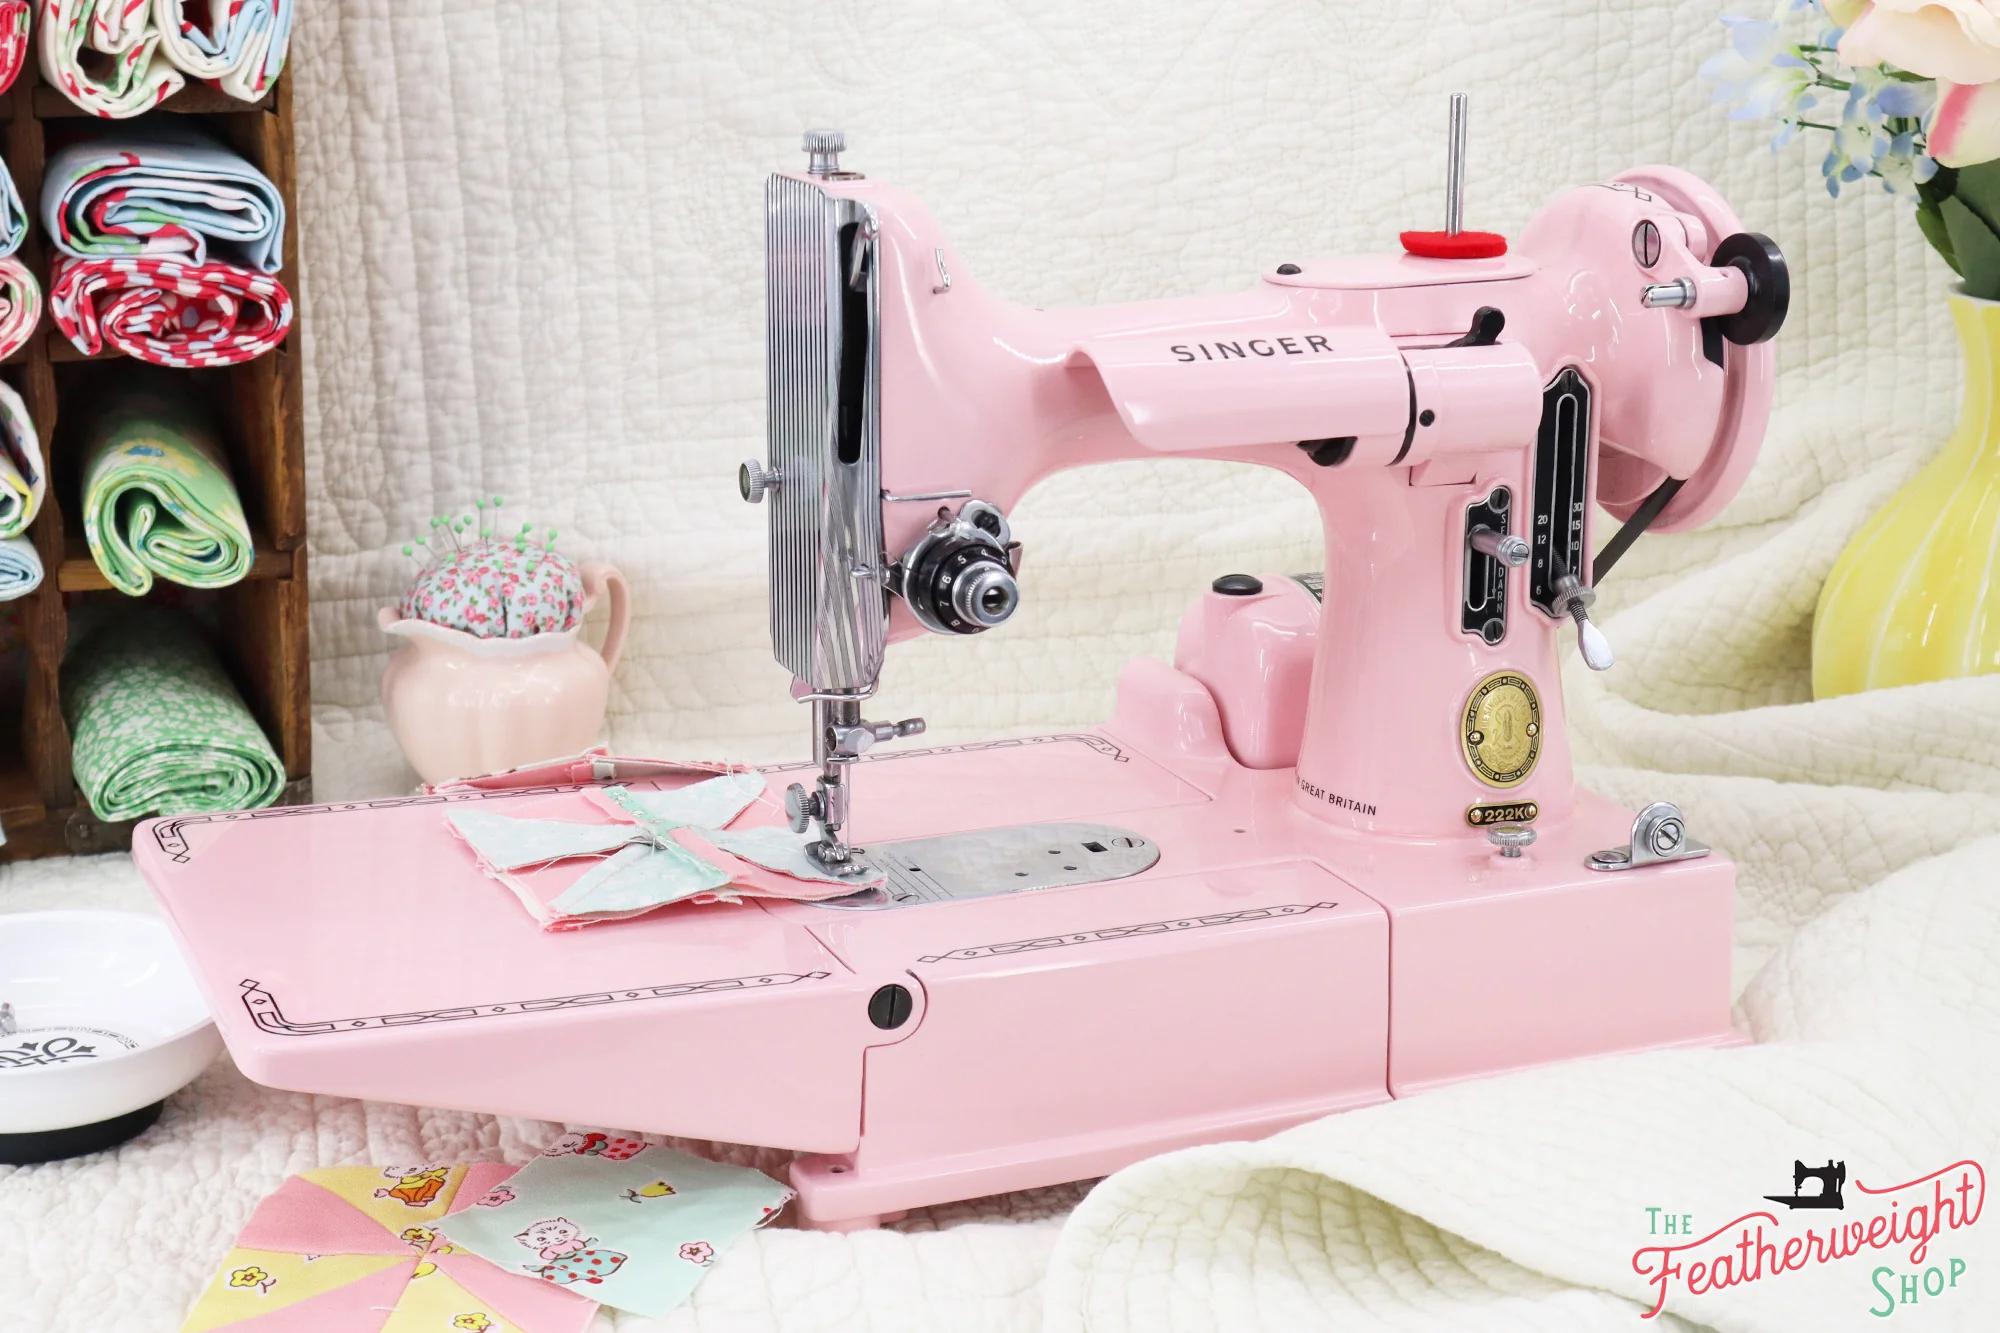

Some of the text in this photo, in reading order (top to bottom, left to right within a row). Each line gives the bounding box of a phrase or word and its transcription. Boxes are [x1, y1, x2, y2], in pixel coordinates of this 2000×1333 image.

[1170, 335, 1334, 362] SINGER
[1572, 502, 1582, 512] 30
[1537, 514, 1548, 525] 20
[1572, 520, 1581, 530] 15
[1537, 534, 1547, 545] 12
[1571, 540, 1580, 551] 10
[957, 555, 967, 565] 5
[1537, 558, 1543, 568] 8
[942, 575, 952, 584] 6
[1496, 567, 1504, 613] DARN
[1535, 585, 1542, 595] 6
[951, 619, 961, 627] 8
[1301, 779, 1325, 800] GREAT
[1328, 793, 1377, 816] BRITAIN
[1484, 806, 1525, 822] 222K
